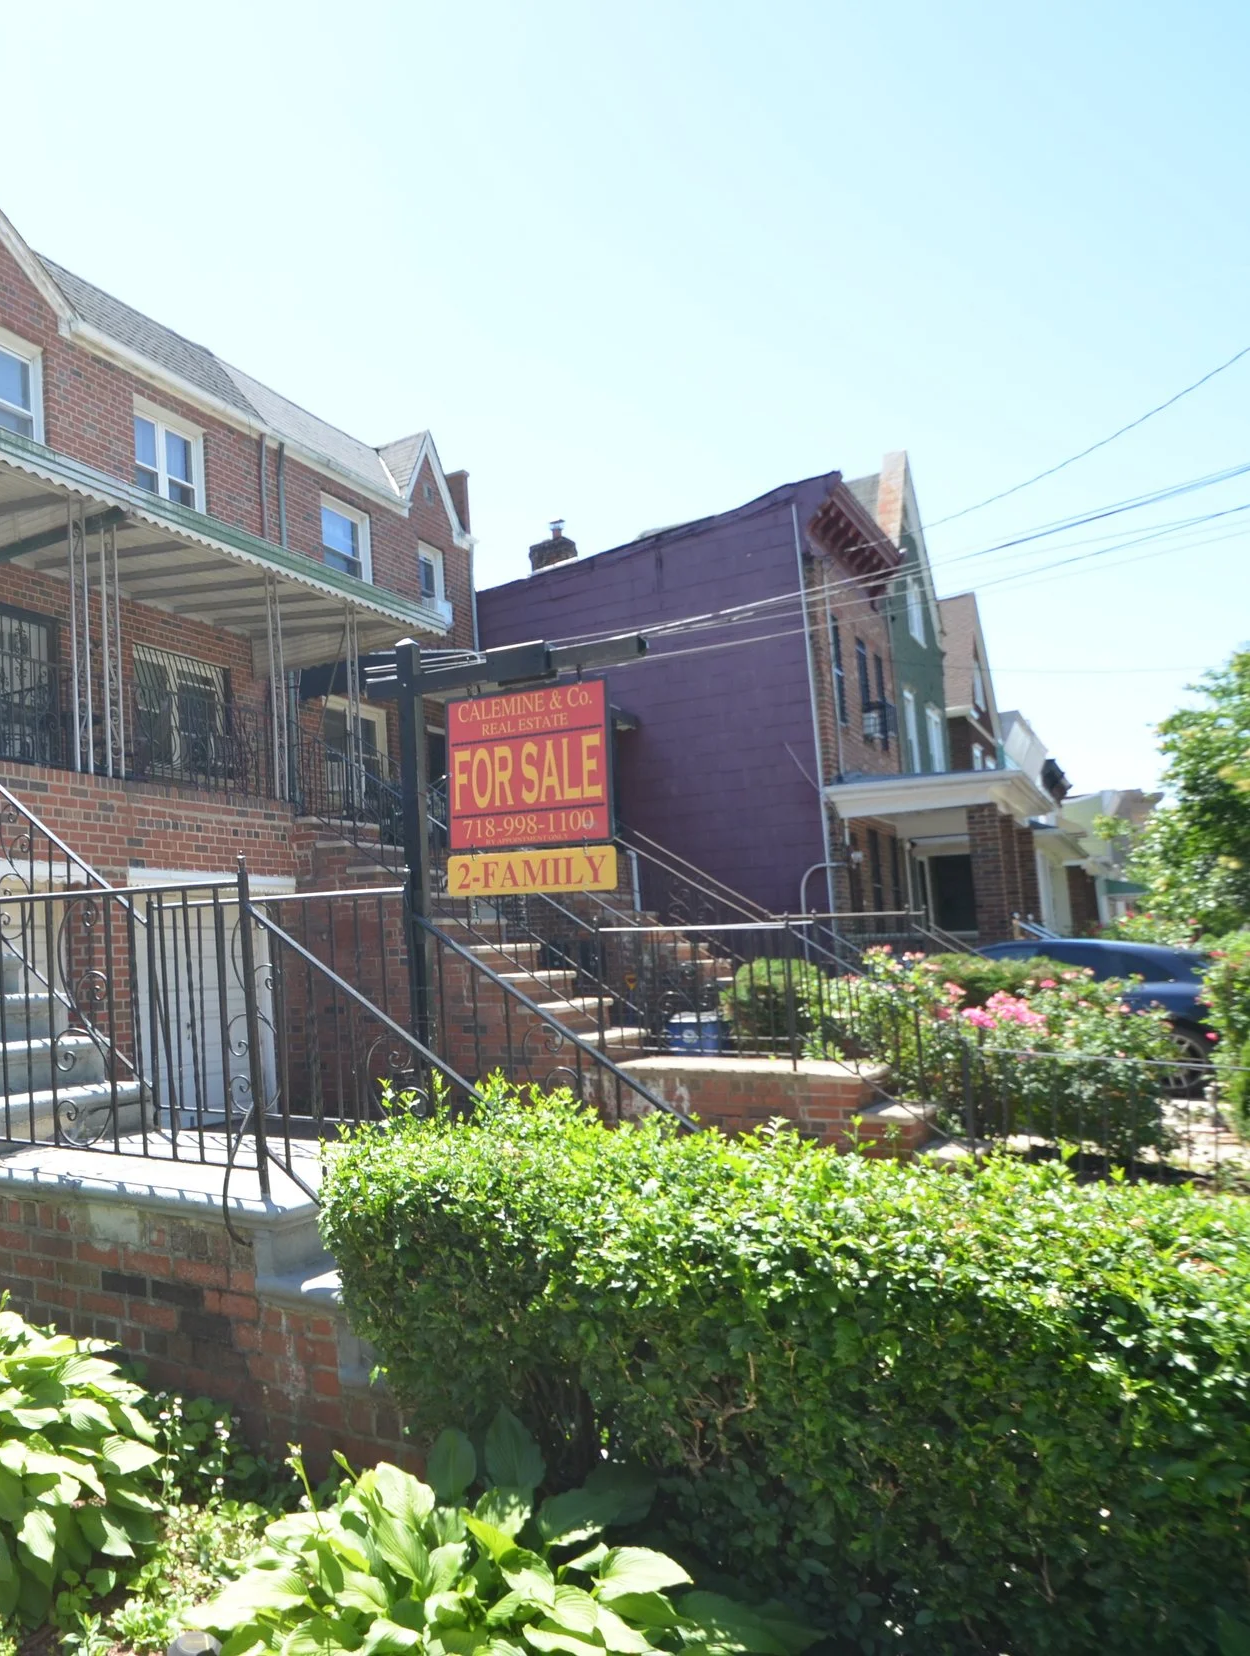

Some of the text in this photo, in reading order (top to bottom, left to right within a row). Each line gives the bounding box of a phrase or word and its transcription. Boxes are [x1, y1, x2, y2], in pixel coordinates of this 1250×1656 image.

[458, 687, 593, 723] CALEMINE & Co.
[482, 712, 569, 737] REAL ESTATE
[454, 731, 603, 811] FOR SALE
[463, 809, 594, 840] 718-998-1100
[497, 834, 547, 845] APPOINTMENT
[549, 832, 569, 841] ONLY
[457, 854, 607, 890] 2-FAMILY
